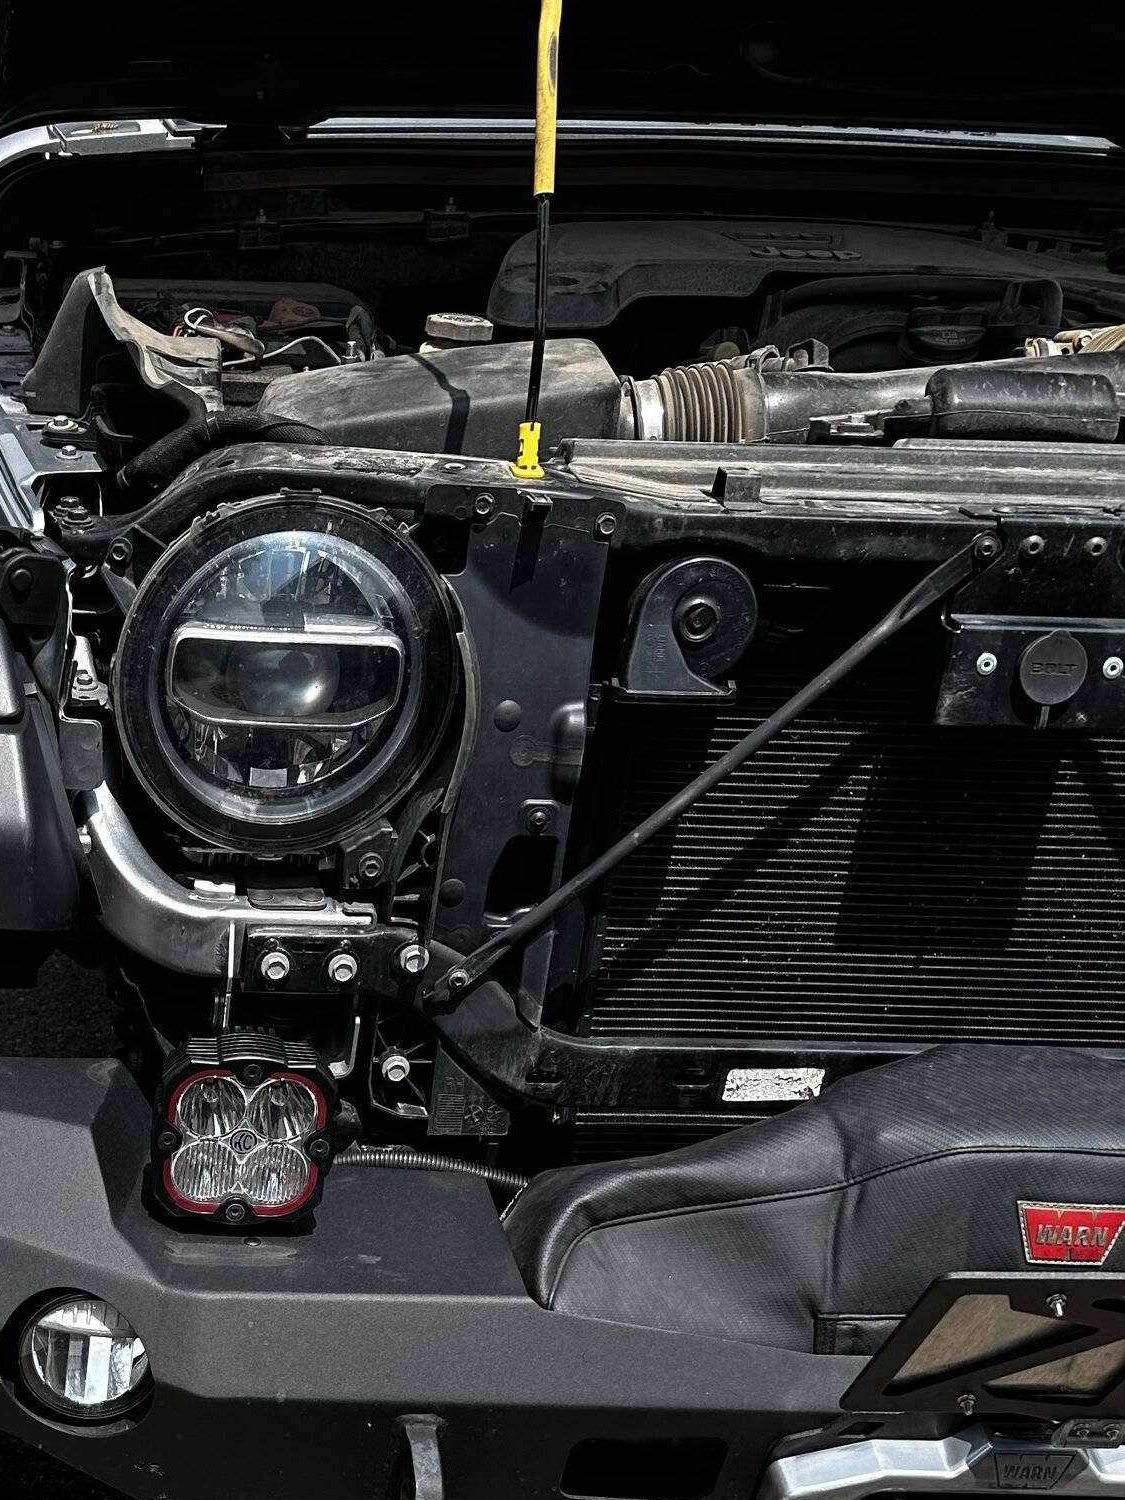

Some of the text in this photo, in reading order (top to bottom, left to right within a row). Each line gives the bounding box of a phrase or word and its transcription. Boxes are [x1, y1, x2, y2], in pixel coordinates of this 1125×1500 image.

[750, 246, 862, 262] Jeep
[1031, 662, 1078, 675] BOLT
[234, 1132, 253, 1151] KC
[1035, 1223, 1109, 1248] WARN
[1002, 1464, 1058, 1480] WARN
